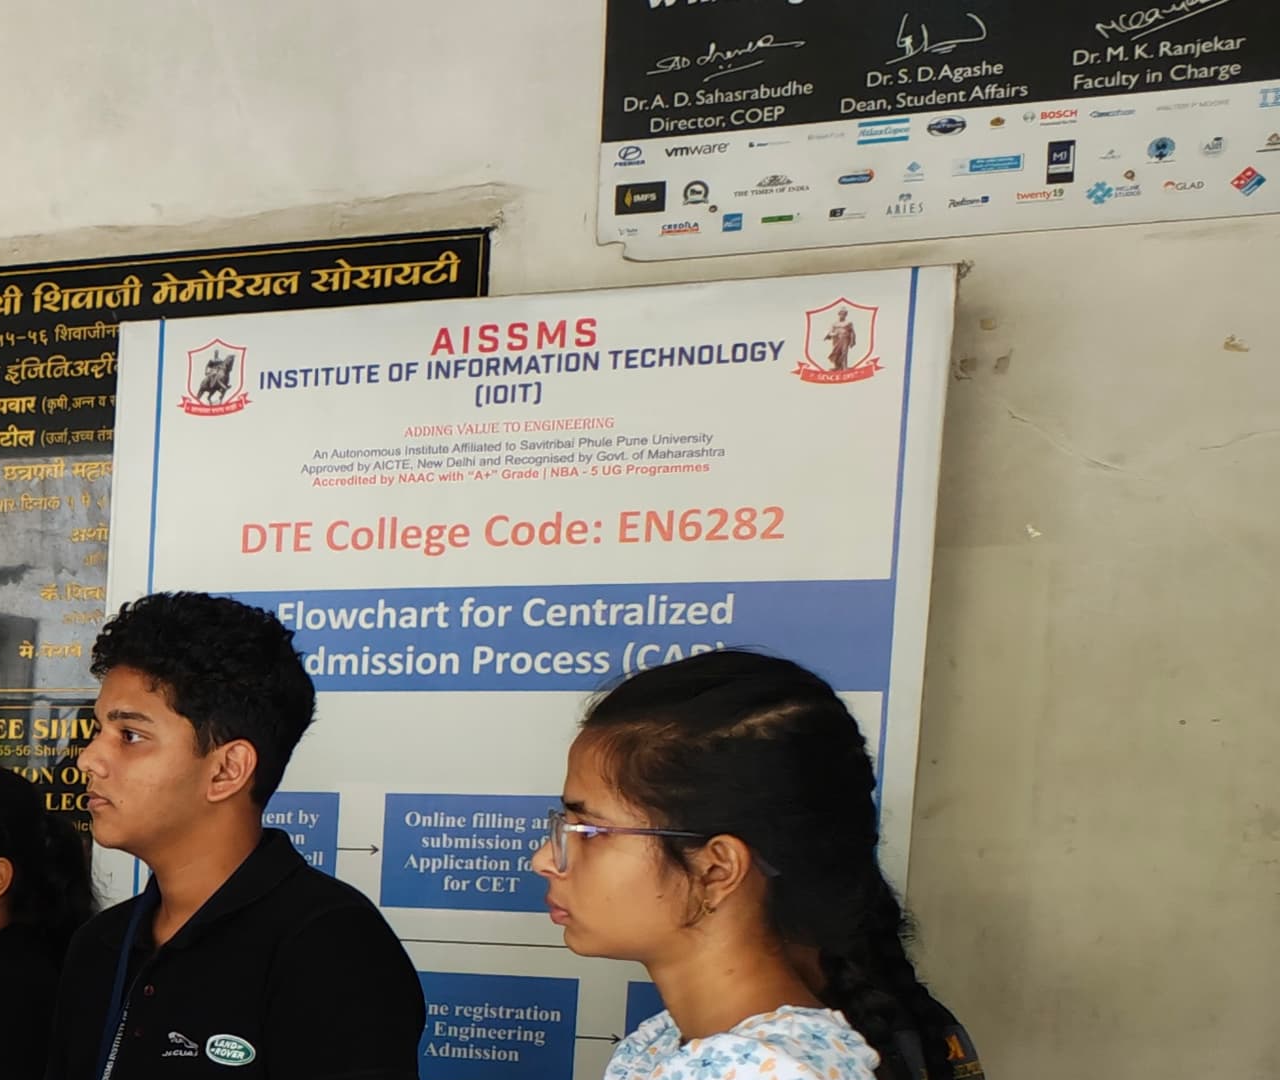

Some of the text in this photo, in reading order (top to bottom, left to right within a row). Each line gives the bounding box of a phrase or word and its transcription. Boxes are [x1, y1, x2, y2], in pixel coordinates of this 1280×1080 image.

[1073, 36, 1247, 66] Dr. M. Ranjekar
[1073, 62, 1241, 90] Faculty in Charge
[696, 81, 814, 105] Sahasrabudhe
[840, 83, 1028, 114] Dean, Student Affairs
[649, 106, 785, 134] Director, COEP
[1040, 109, 1078, 119] BOSCH
[32, 275, 142, 313] शिवाजी
[152, 267, 301, 305] मेमोरियल
[311, 251, 461, 292] सोसायटी
[430, 318, 598, 356] AISSMS
[259, 340, 785, 390] INSTITUTE OF INFORMATION TECHNOLOGY
[405, 417, 615, 438] ADDING VALUE ENGINEERING
[331, 432, 714, 460] Autonomous Institute Affiliated Savitribai University
[301, 446, 725, 476] Approved Recognised Maharashtra
[312, 461, 710, 488] Accredited NAAC Grade Programmes
[241, 506, 785, 557] DTE College Code: EN6282
[459, 597, 512, 628] for
[522, 594, 735, 627] Centralized
[304, 642, 611, 677] dmission Process
[405, 811, 526, 834] Online filling
[421, 832, 523, 851] submission
[404, 853, 511, 875] Application
[443, 874, 520, 894] for CET
[454, 1002, 561, 1024] registration
[215, 1040, 237, 1050] LAND
[434, 1020, 545, 1046] Engineering
[215, 1048, 245, 1060] ROVER
[423, 1041, 519, 1062] Admission
